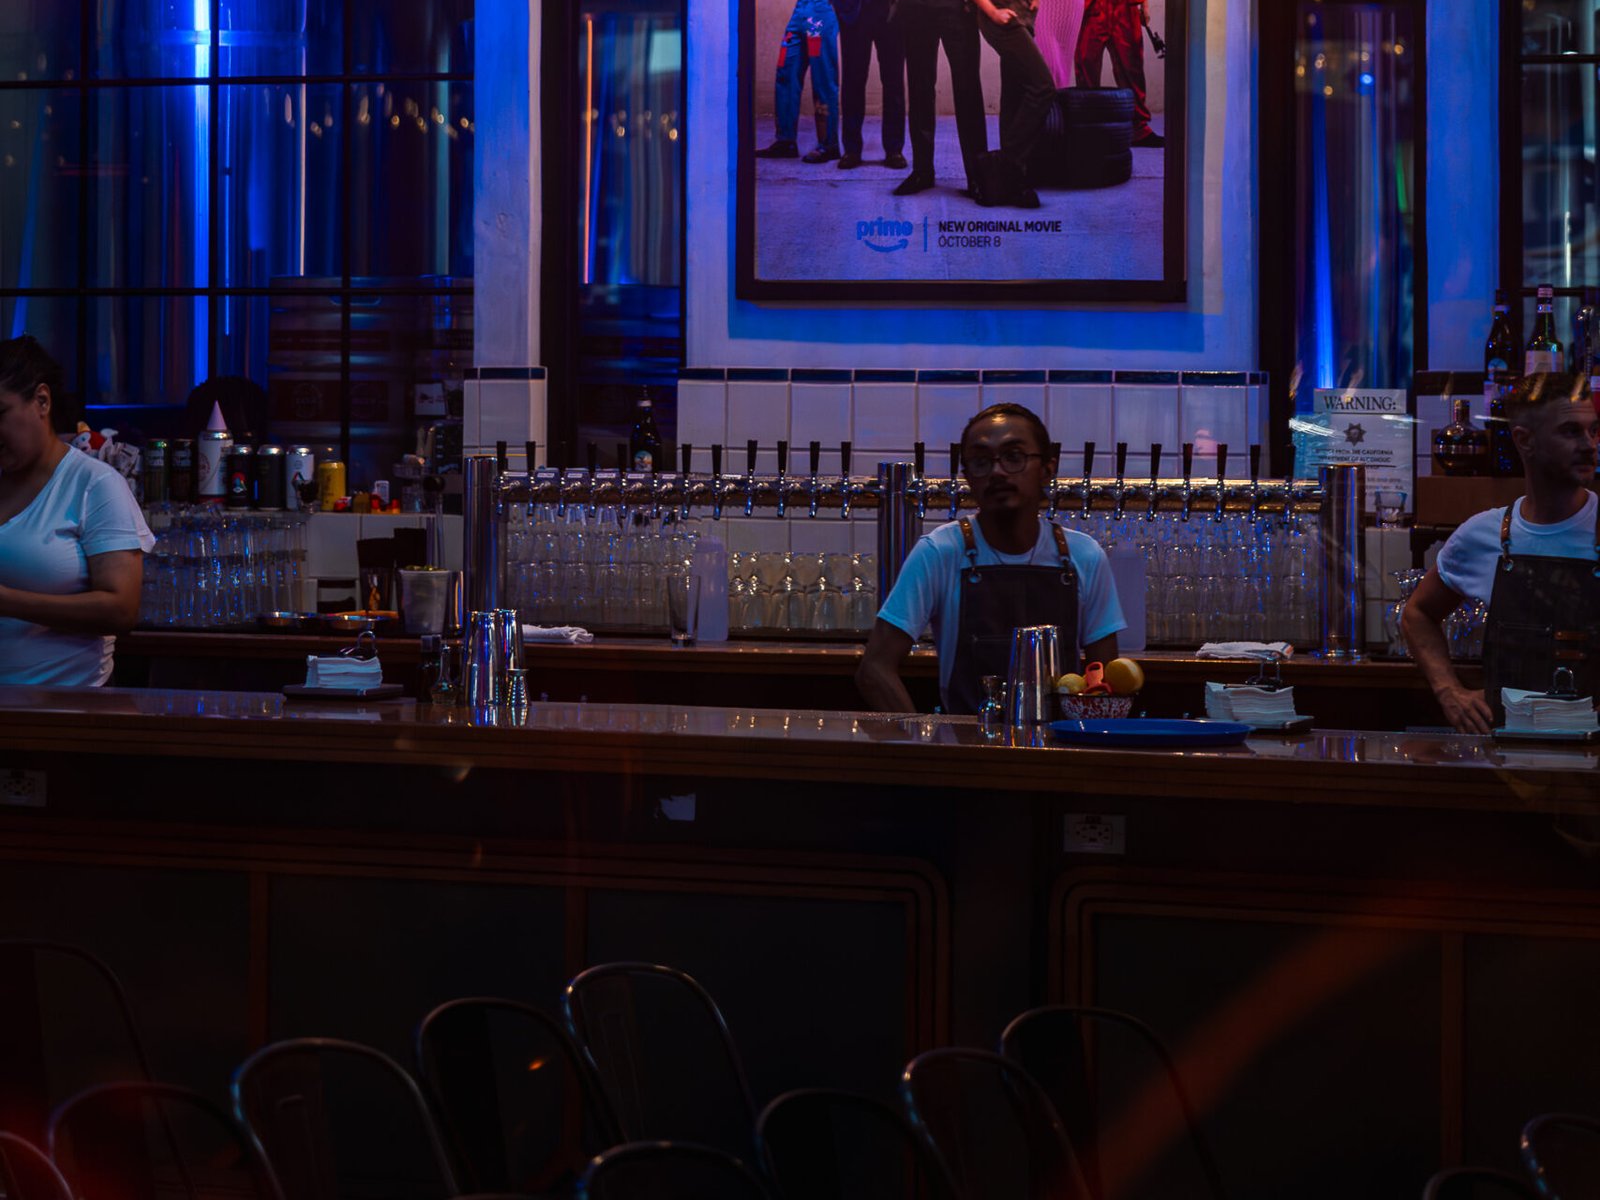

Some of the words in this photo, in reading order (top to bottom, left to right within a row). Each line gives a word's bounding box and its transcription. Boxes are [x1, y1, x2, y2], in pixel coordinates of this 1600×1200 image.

[856, 216, 914, 241] prime
[938, 220, 968, 233] NEW
[968, 220, 1023, 233] ORIGINAL
[1024, 220, 1062, 233] MOVIE
[938, 235, 992, 248] OCTOBER
[993, 235, 1002, 248] 8
[1323, 395, 1397, 411] WARNING:
